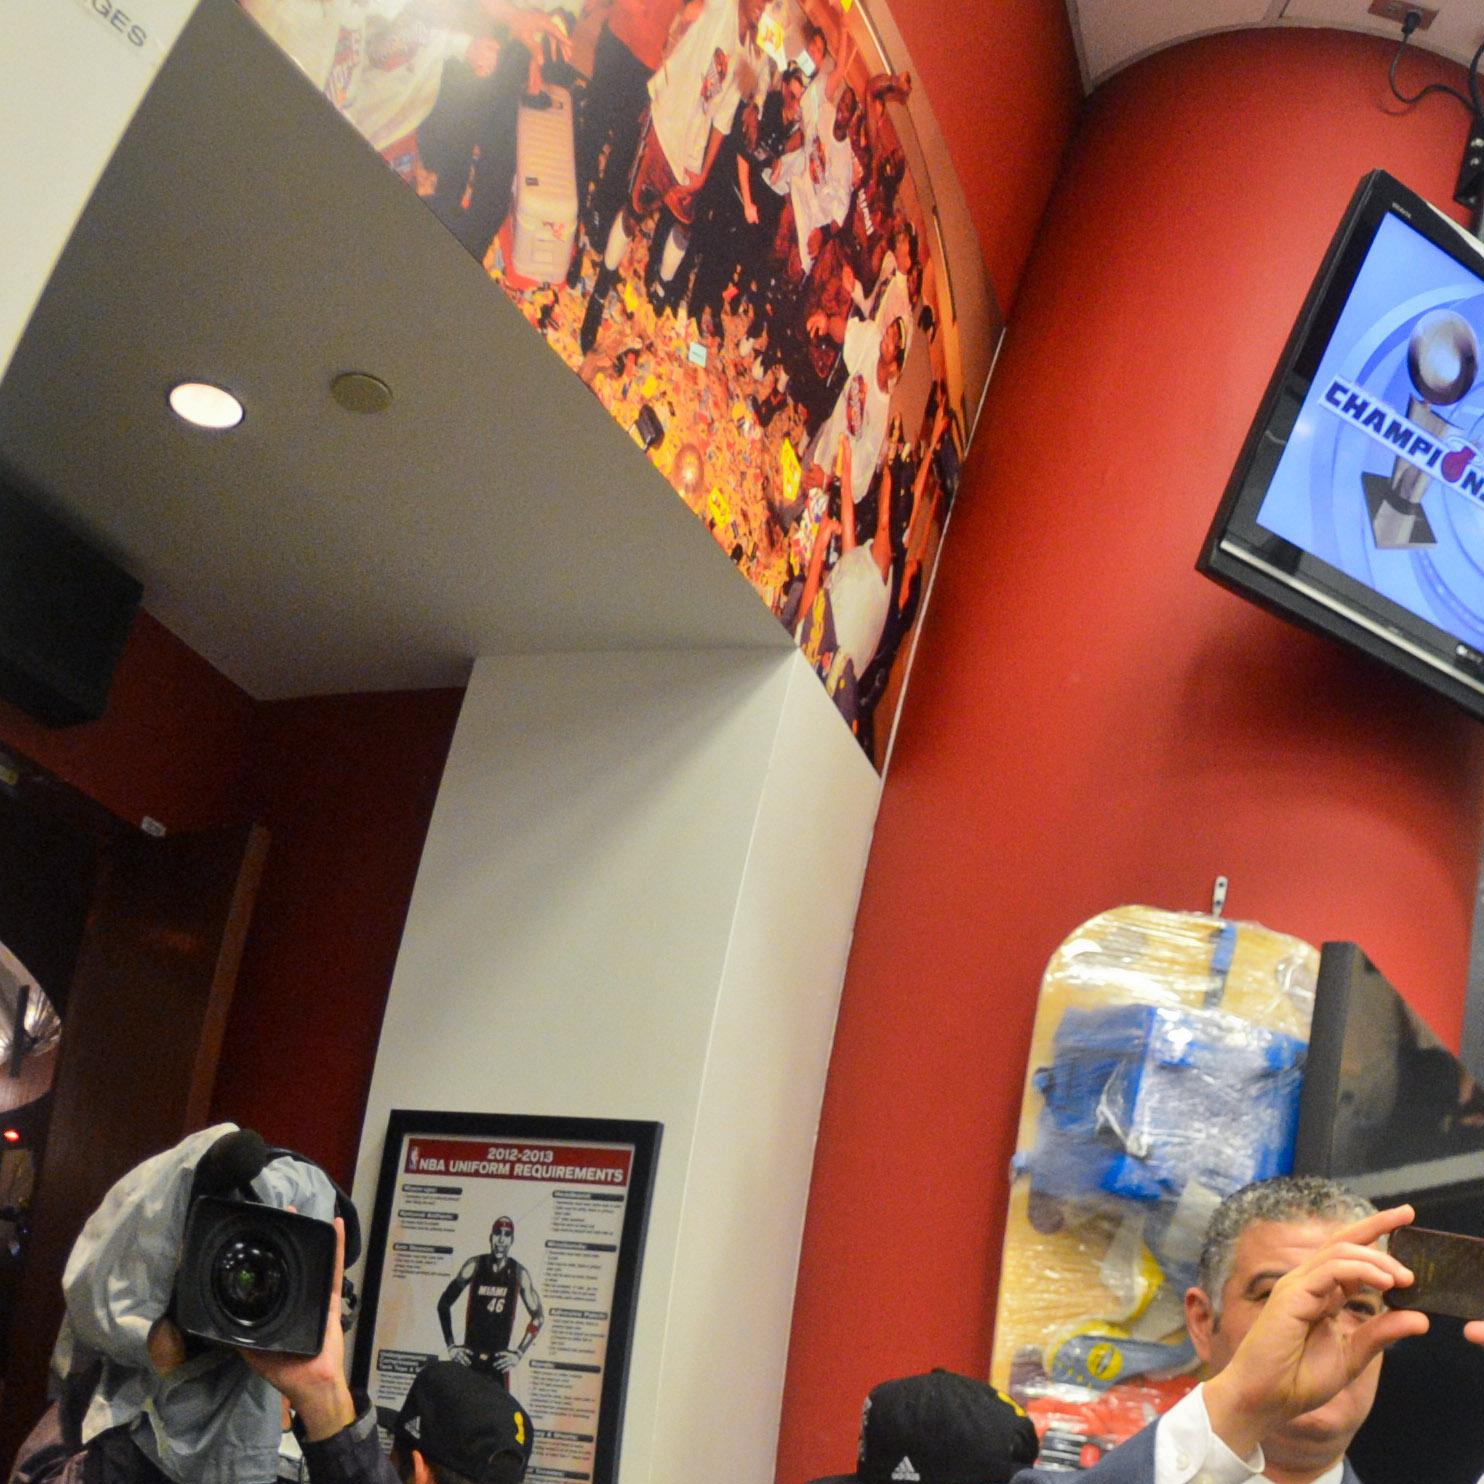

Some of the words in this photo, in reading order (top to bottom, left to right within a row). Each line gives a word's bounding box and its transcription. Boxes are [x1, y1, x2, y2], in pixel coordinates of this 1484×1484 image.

[486, 1146, 554, 1164] 2012-2013
[418, 1157, 447, 1172] NBA
[449, 1159, 511, 1177] UNIFORM
[513, 1163, 625, 1184] REQUIREMENTS
[486, 1297, 506, 1313] 46
